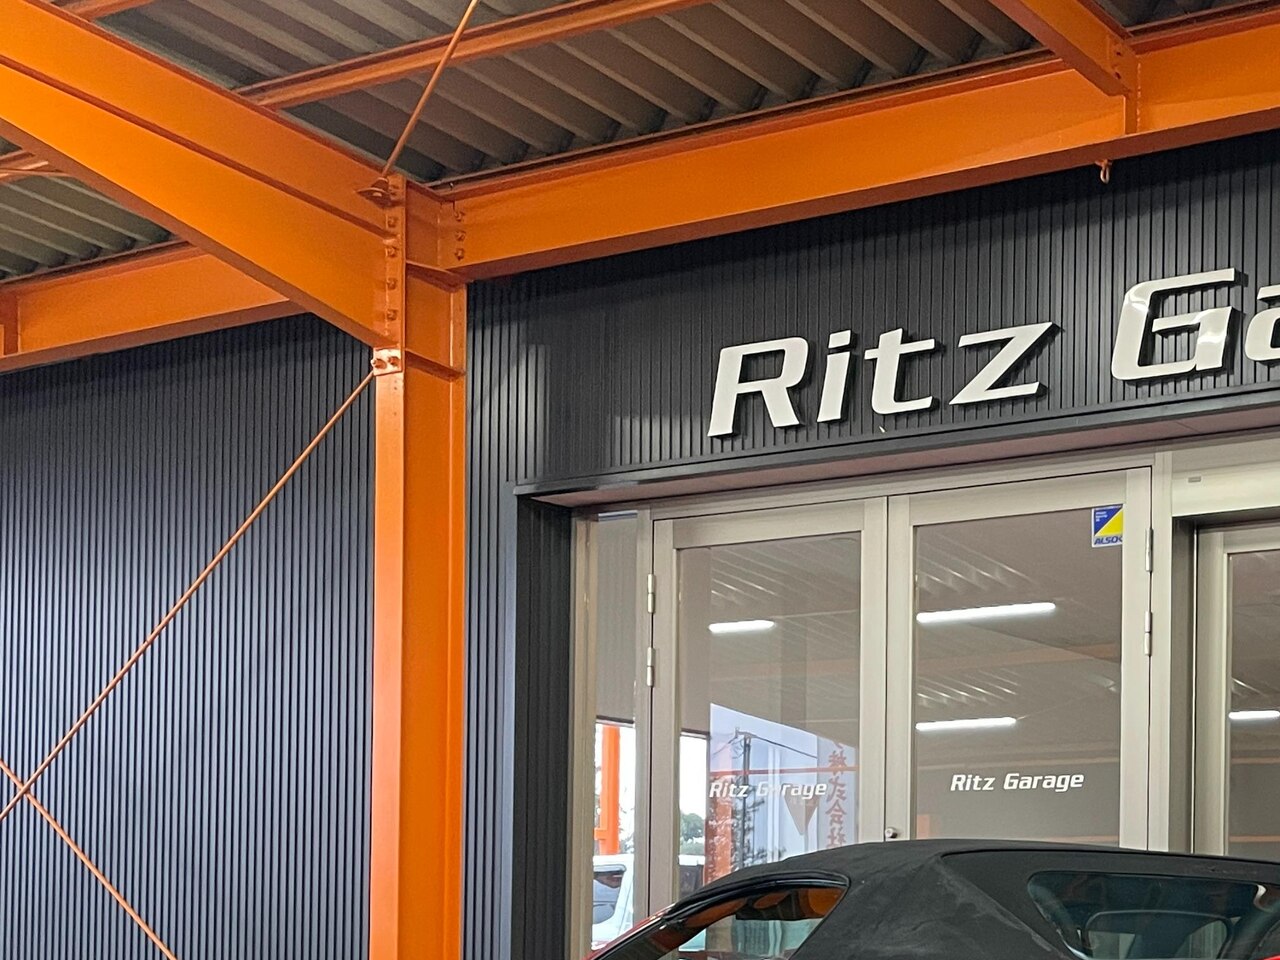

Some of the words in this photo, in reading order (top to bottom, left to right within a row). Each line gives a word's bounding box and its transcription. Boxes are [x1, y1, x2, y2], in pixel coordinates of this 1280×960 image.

[707, 321, 1053, 438] Ritz
[709, 782, 748, 798] Ritz
[756, 781, 828, 799] Grage
[950, 774, 996, 791] Ritz
[1003, 773, 1085, 792] Garage
